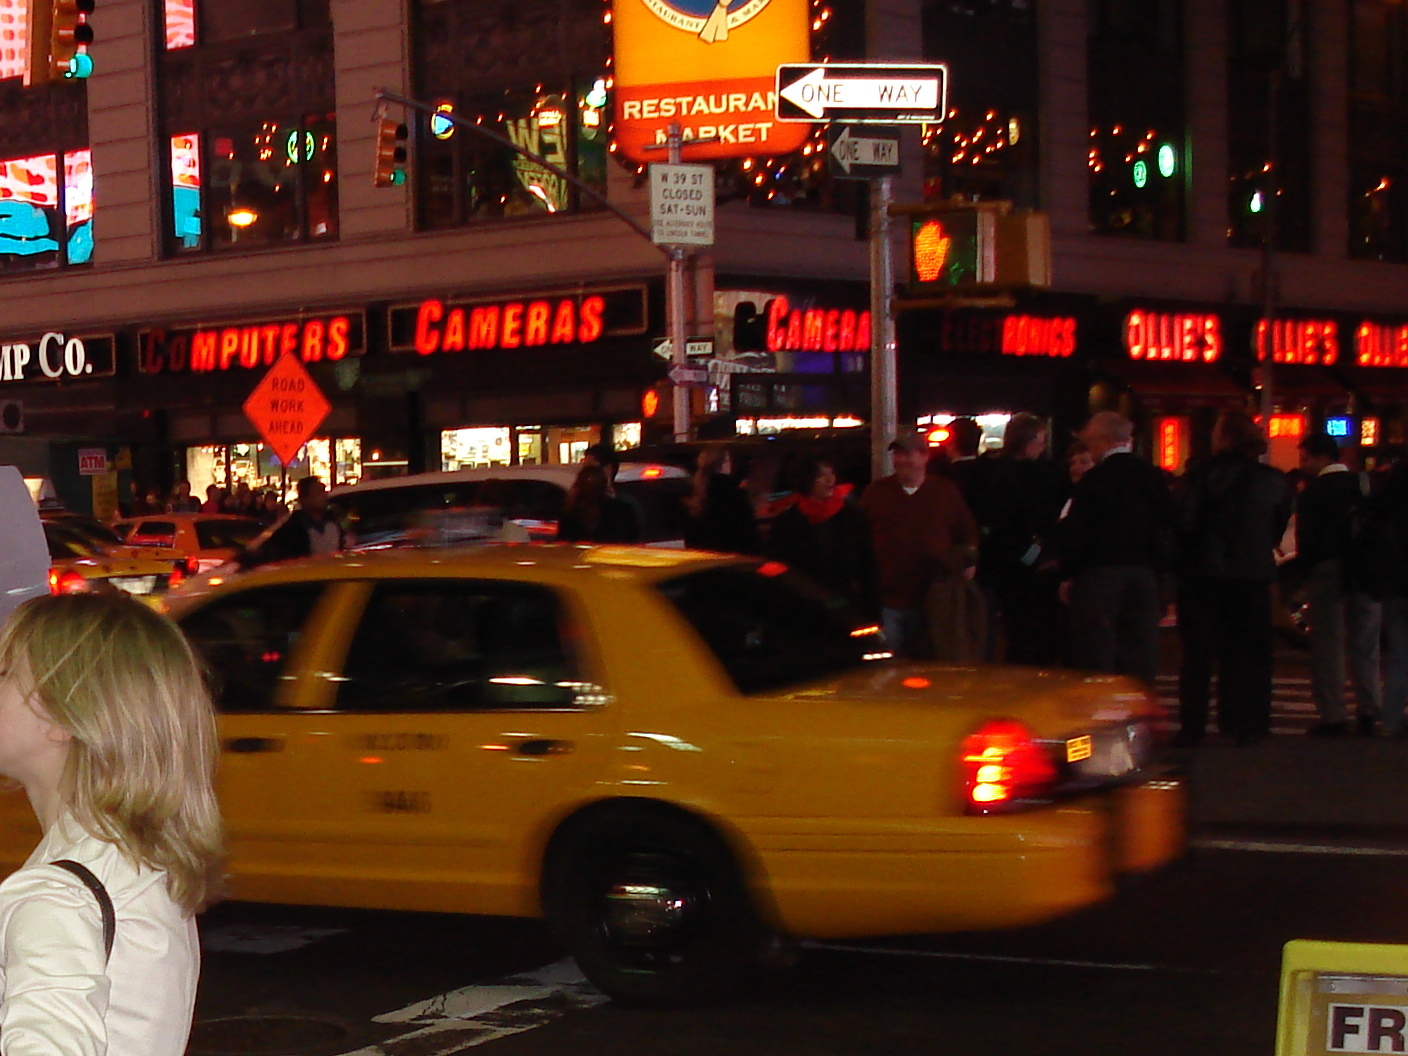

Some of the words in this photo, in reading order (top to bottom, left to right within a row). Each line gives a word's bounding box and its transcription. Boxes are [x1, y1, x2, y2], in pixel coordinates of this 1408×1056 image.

[801, 83, 844, 103] ONE
[878, 84, 923, 103] WAY
[623, 91, 776, 120] RESTAURAN
[838, 139, 860, 161] ONE
[871, 141, 893, 163] WAY
[662, 188, 703, 201] CLOSED
[415, 296, 605, 356] CAMERAS
[767, 295, 871, 352] CAMERA
[144, 316, 349, 373] COMPUTERS
[1126, 311, 1221, 362] OLLIE'S
[38, 332, 93, 378] CO.
[272, 377, 305, 392] ROAD
[270, 399, 304, 413] WORK
[268, 420, 303, 435] AHEAD
[81, 456, 105, 469] ATM
